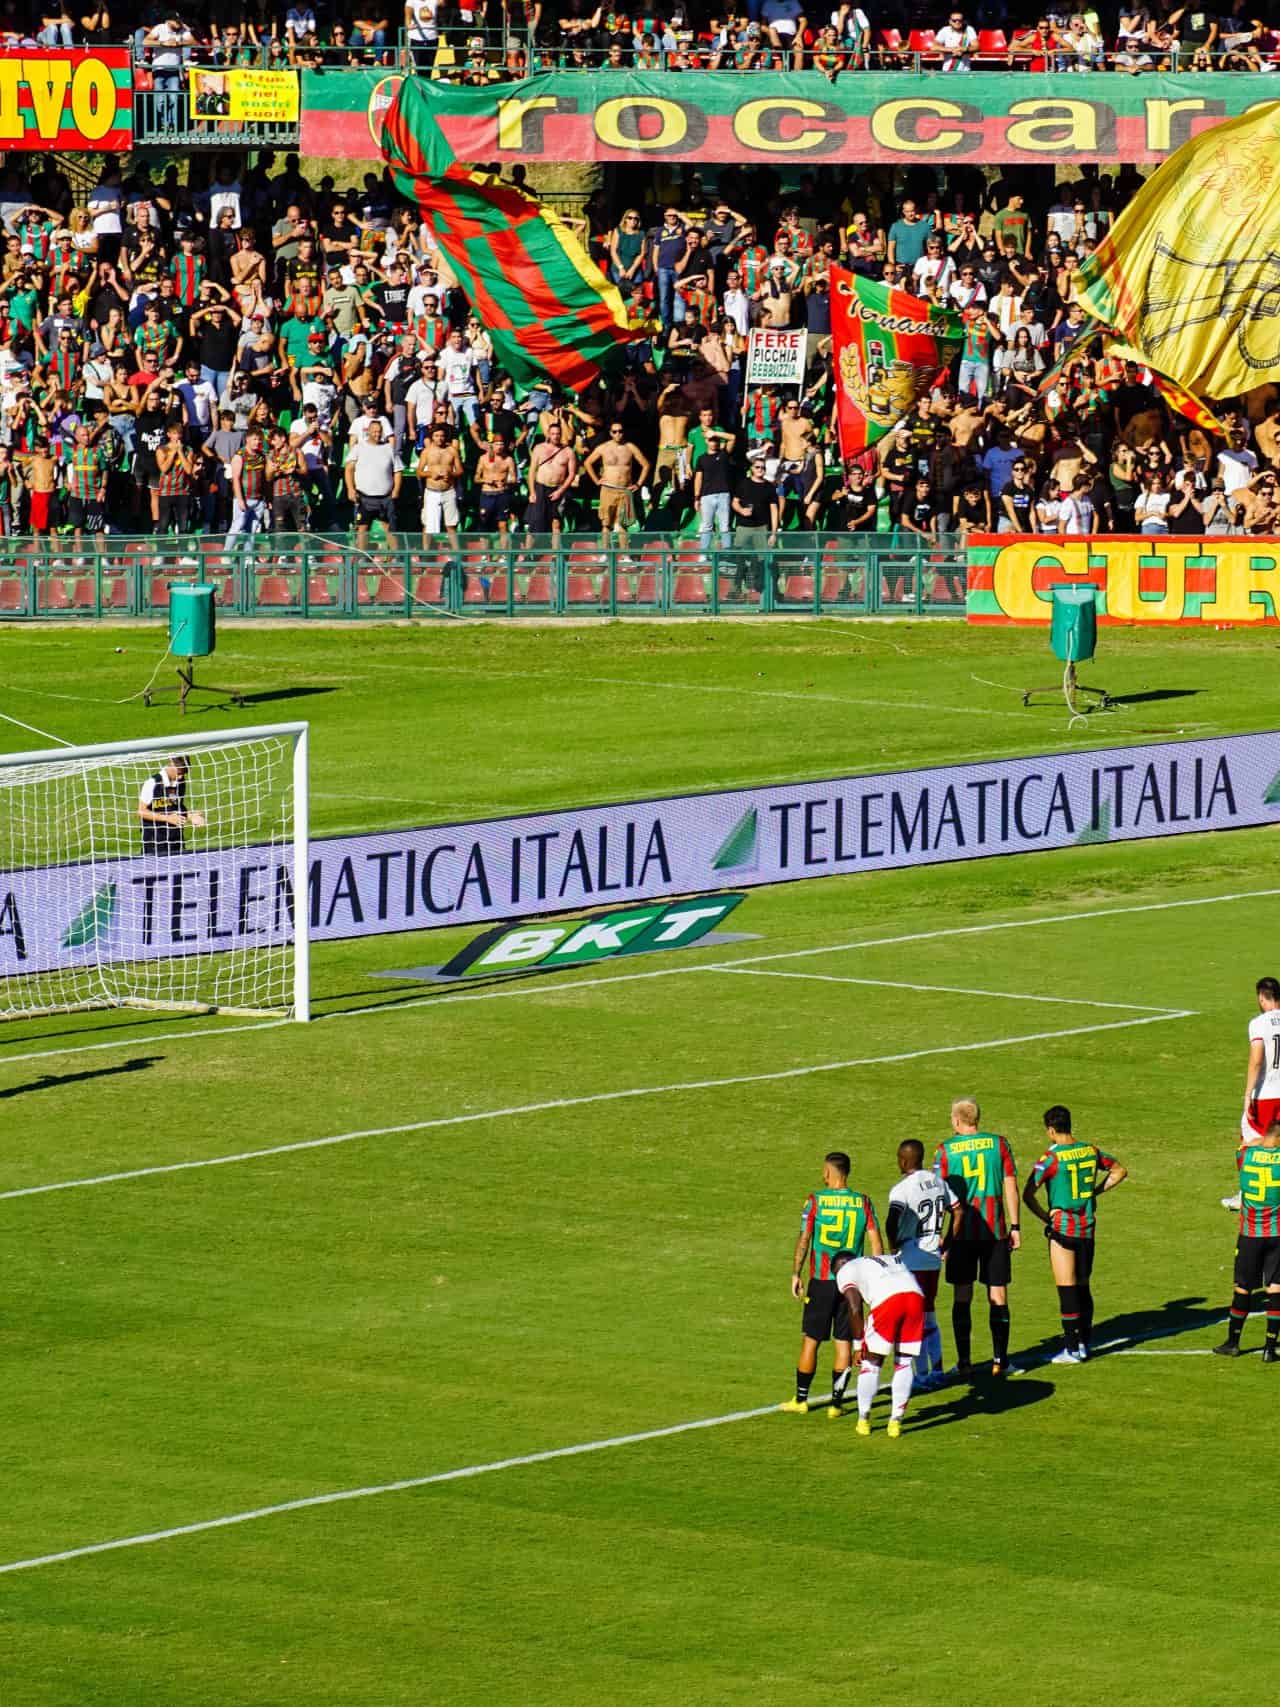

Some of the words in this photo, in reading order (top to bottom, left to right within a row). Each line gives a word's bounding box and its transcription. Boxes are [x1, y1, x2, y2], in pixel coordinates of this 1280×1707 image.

[753, 348, 797, 362] PICCHIA
[755, 333, 800, 348] FERE
[769, 772, 1075, 868] TELEMATICA
[1091, 754, 1238, 832] ITALIA
[132, 841, 493, 945] TELEMATICA
[511, 818, 673, 903] ITALIA
[478, 905, 728, 966] BKT
[962, 1153, 985, 1191] 4
[1067, 1160, 1097, 1200] 13
[820, 1209, 857, 1248] 21
